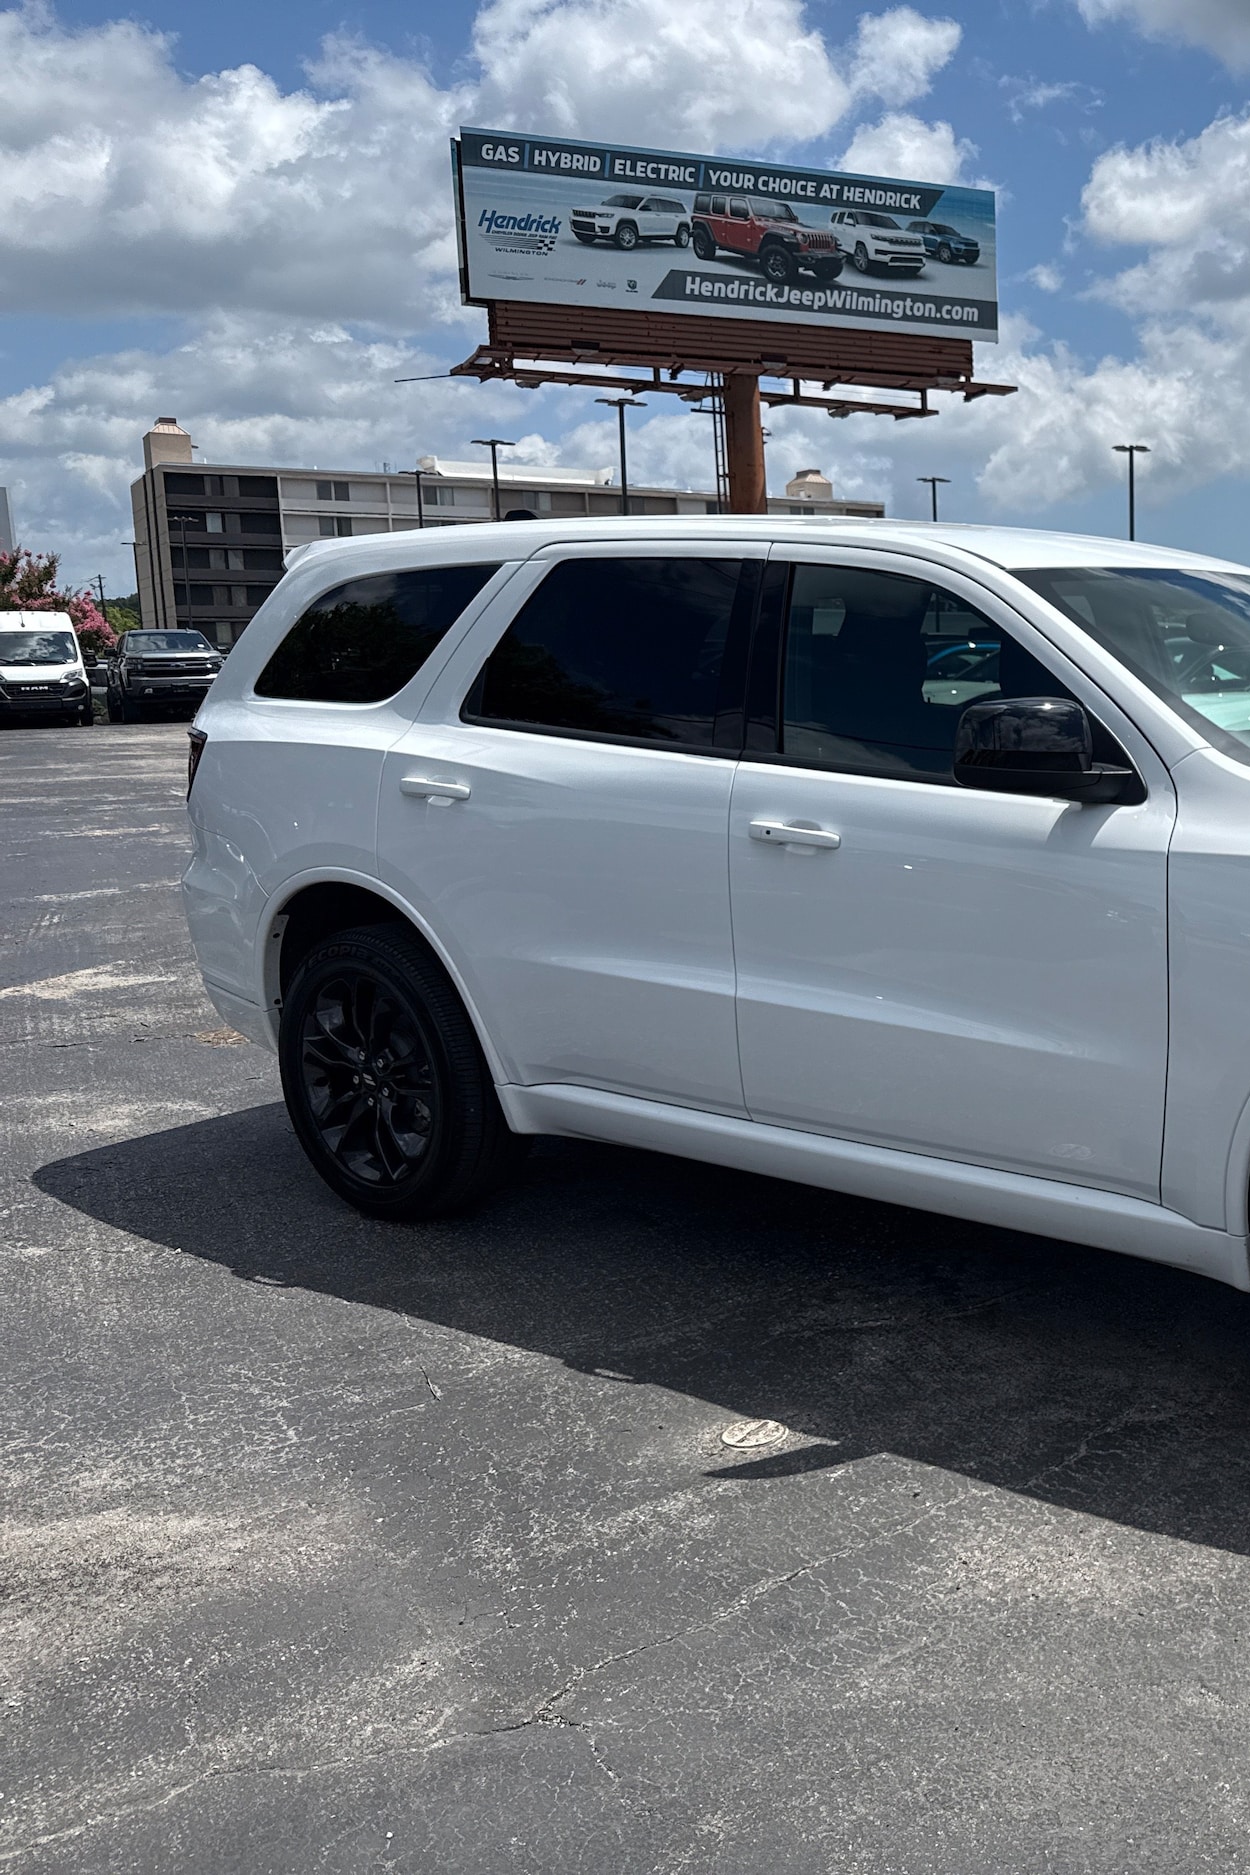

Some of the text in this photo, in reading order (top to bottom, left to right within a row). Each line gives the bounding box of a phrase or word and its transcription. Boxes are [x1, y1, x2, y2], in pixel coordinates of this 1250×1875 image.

[481, 143, 921, 209] GAS HYBRID ELECTRIC YOUR CHOICE AT HENDRICK
[478, 209, 562, 234] Hendrick
[495, 247, 549, 256] WILMINGTON
[685, 276, 979, 322] HendrickJeepWilmington.com
